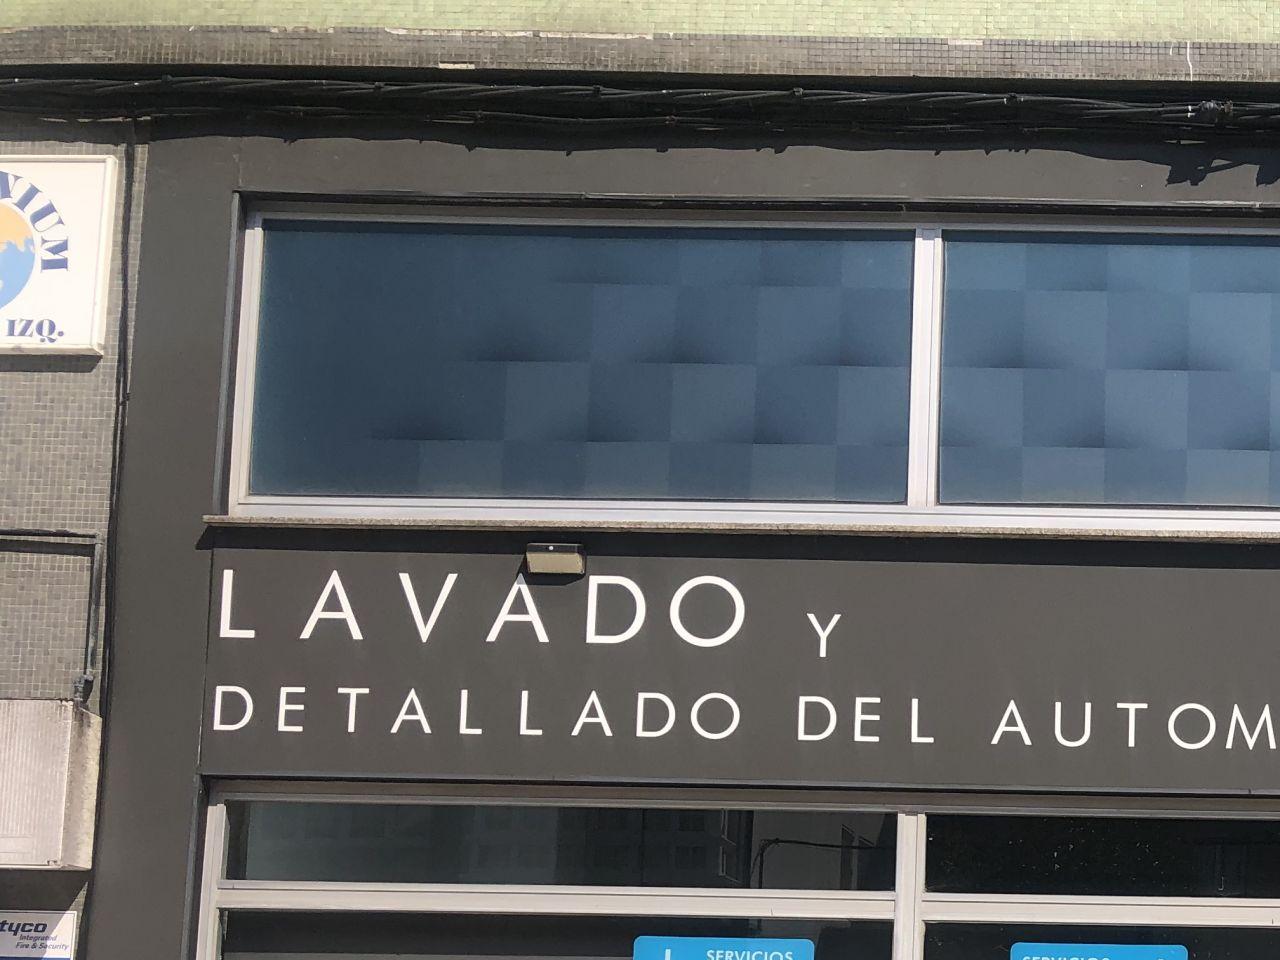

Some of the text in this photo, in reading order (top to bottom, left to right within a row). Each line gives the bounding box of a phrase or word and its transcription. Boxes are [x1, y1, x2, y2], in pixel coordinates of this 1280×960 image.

[6, 319, 64, 343] IZQ.
[219, 570, 841, 657] LAVADO Y
[212, 685, 740, 740] DETALLADO
[797, 695, 934, 743] DEL
